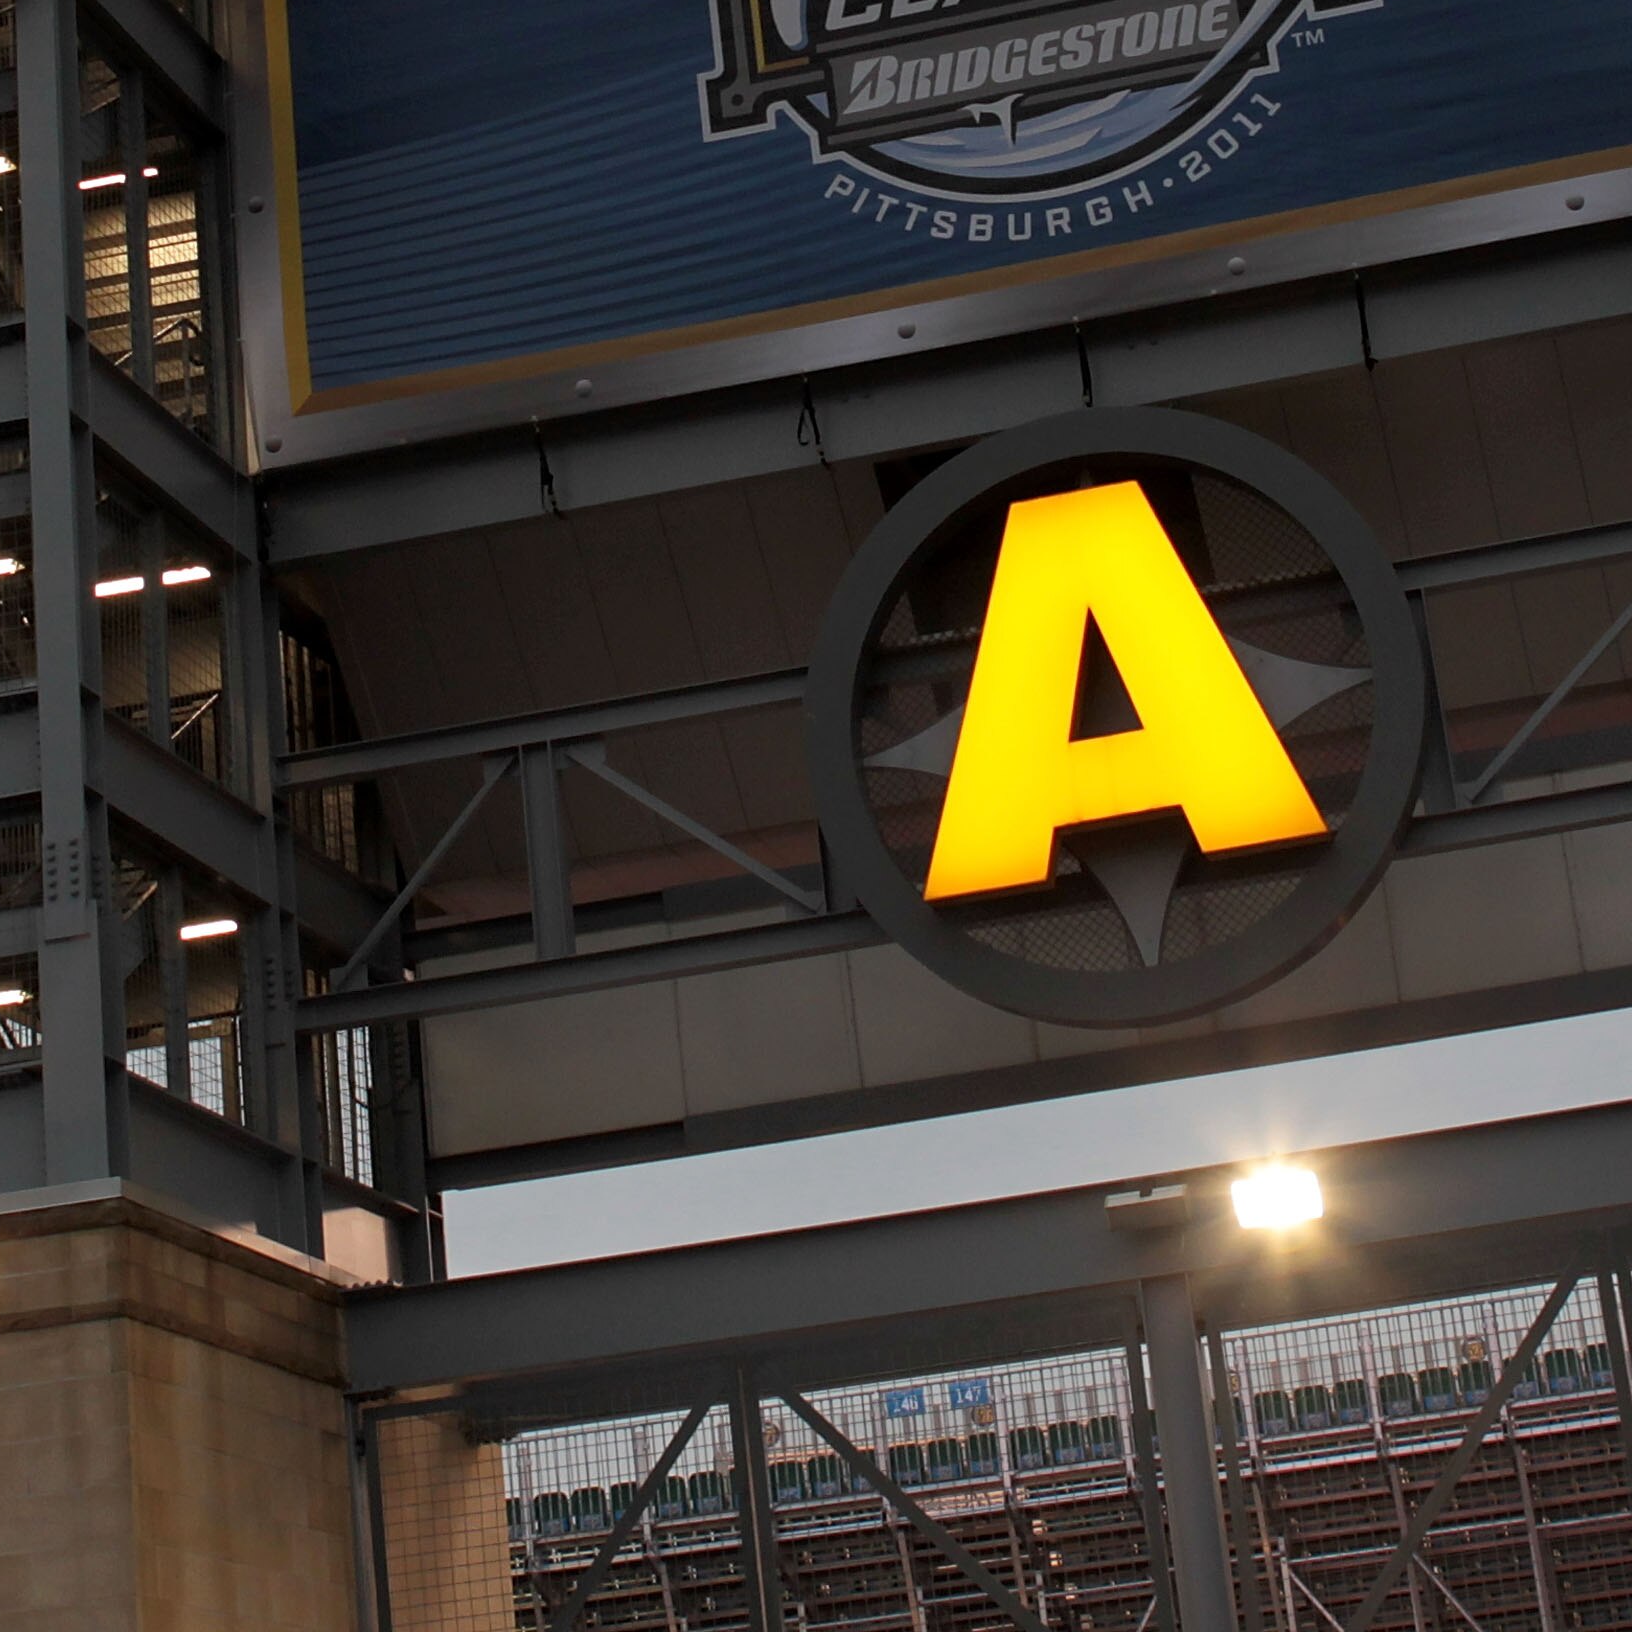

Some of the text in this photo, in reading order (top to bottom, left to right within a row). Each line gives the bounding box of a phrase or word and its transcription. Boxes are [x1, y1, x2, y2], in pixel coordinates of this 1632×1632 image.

[1291, 28, 1325, 49] TM
[823, 97, 1282, 243] PITTSBURGH 2011
[923, 479, 1331, 905] A
